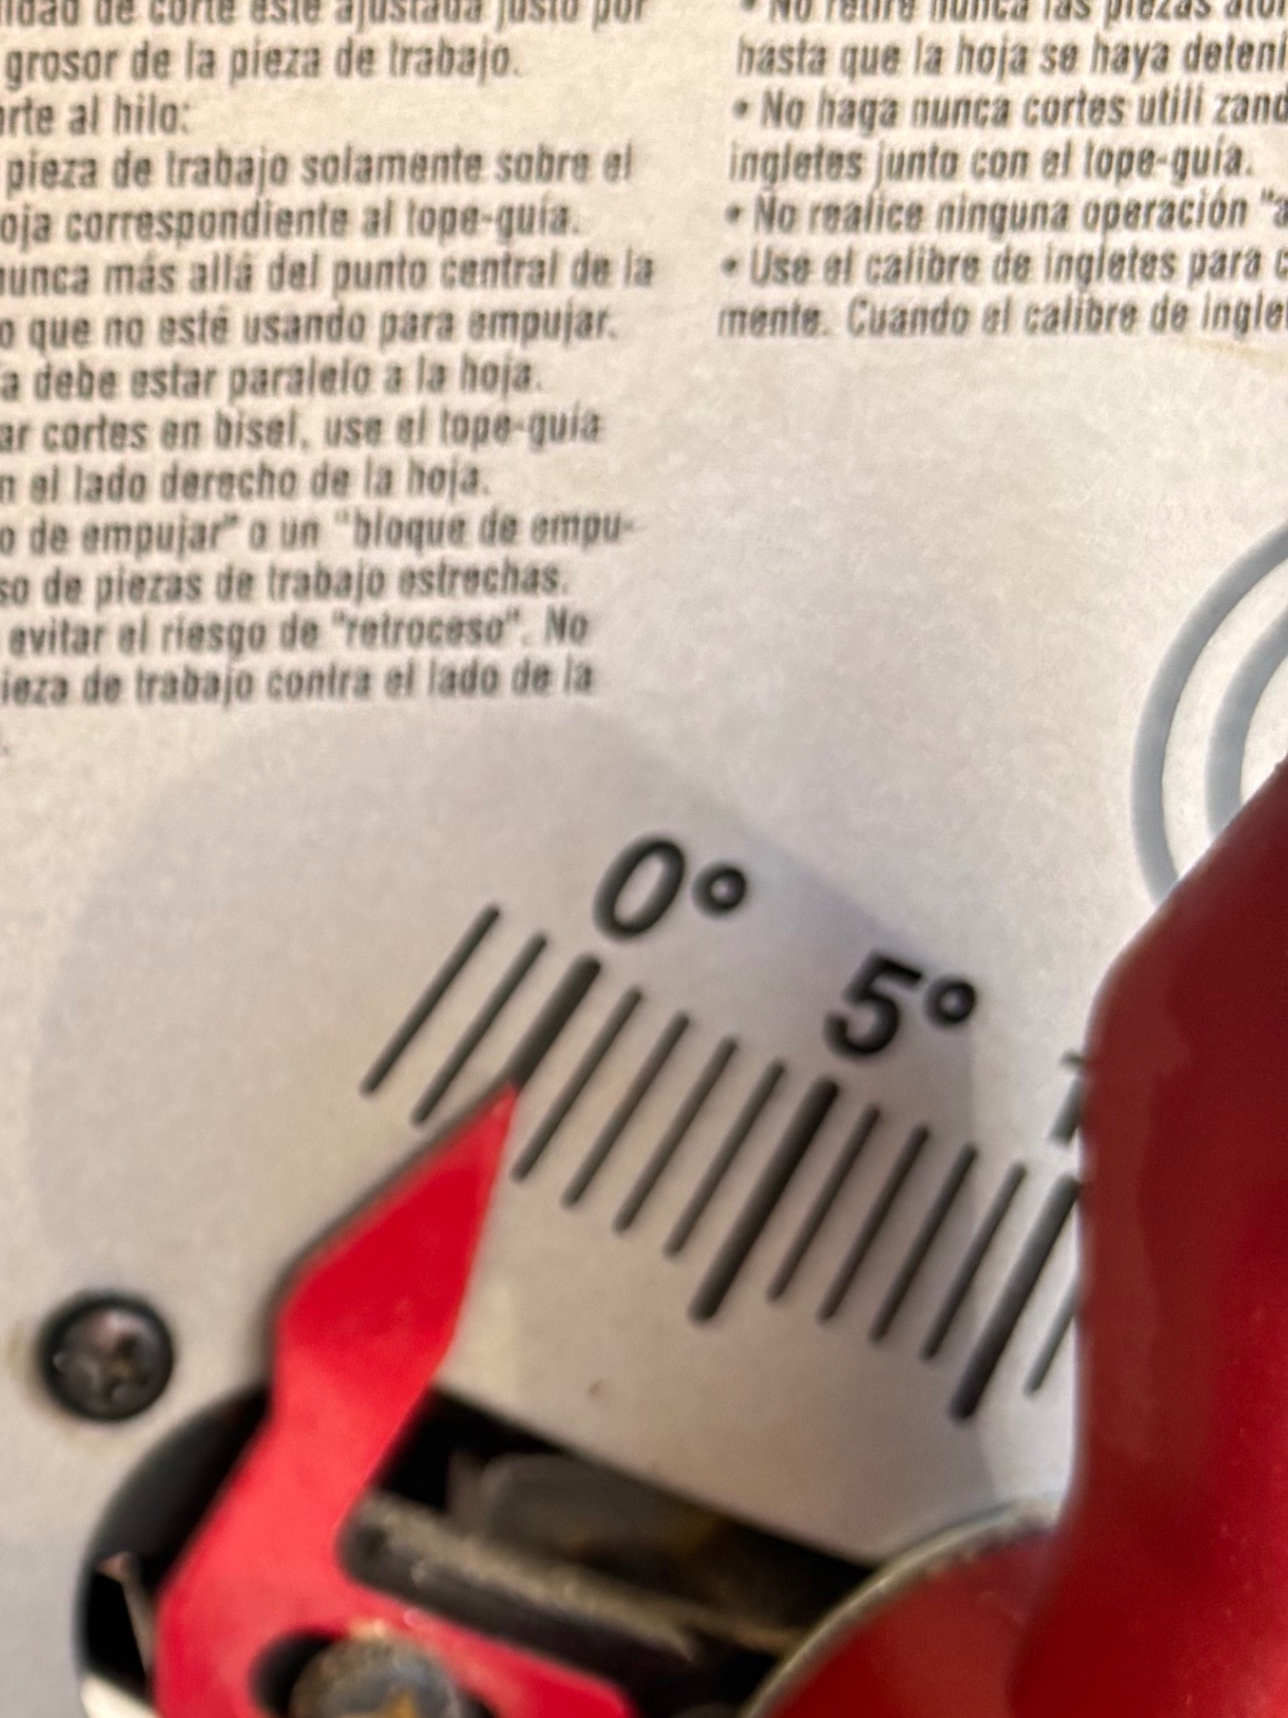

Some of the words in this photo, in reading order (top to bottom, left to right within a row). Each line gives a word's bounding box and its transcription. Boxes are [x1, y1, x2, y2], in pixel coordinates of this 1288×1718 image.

[68, 94, 100, 135] al
[113, 92, 190, 134] hilo:
[731, 143, 866, 192] ingletes
[875, 143, 960, 189] junto
[971, 149, 1030, 180] con
[1042, 139, 1073, 180] el
[593, 832, 747, 943] 0°
[825, 949, 978, 1059] 5°
